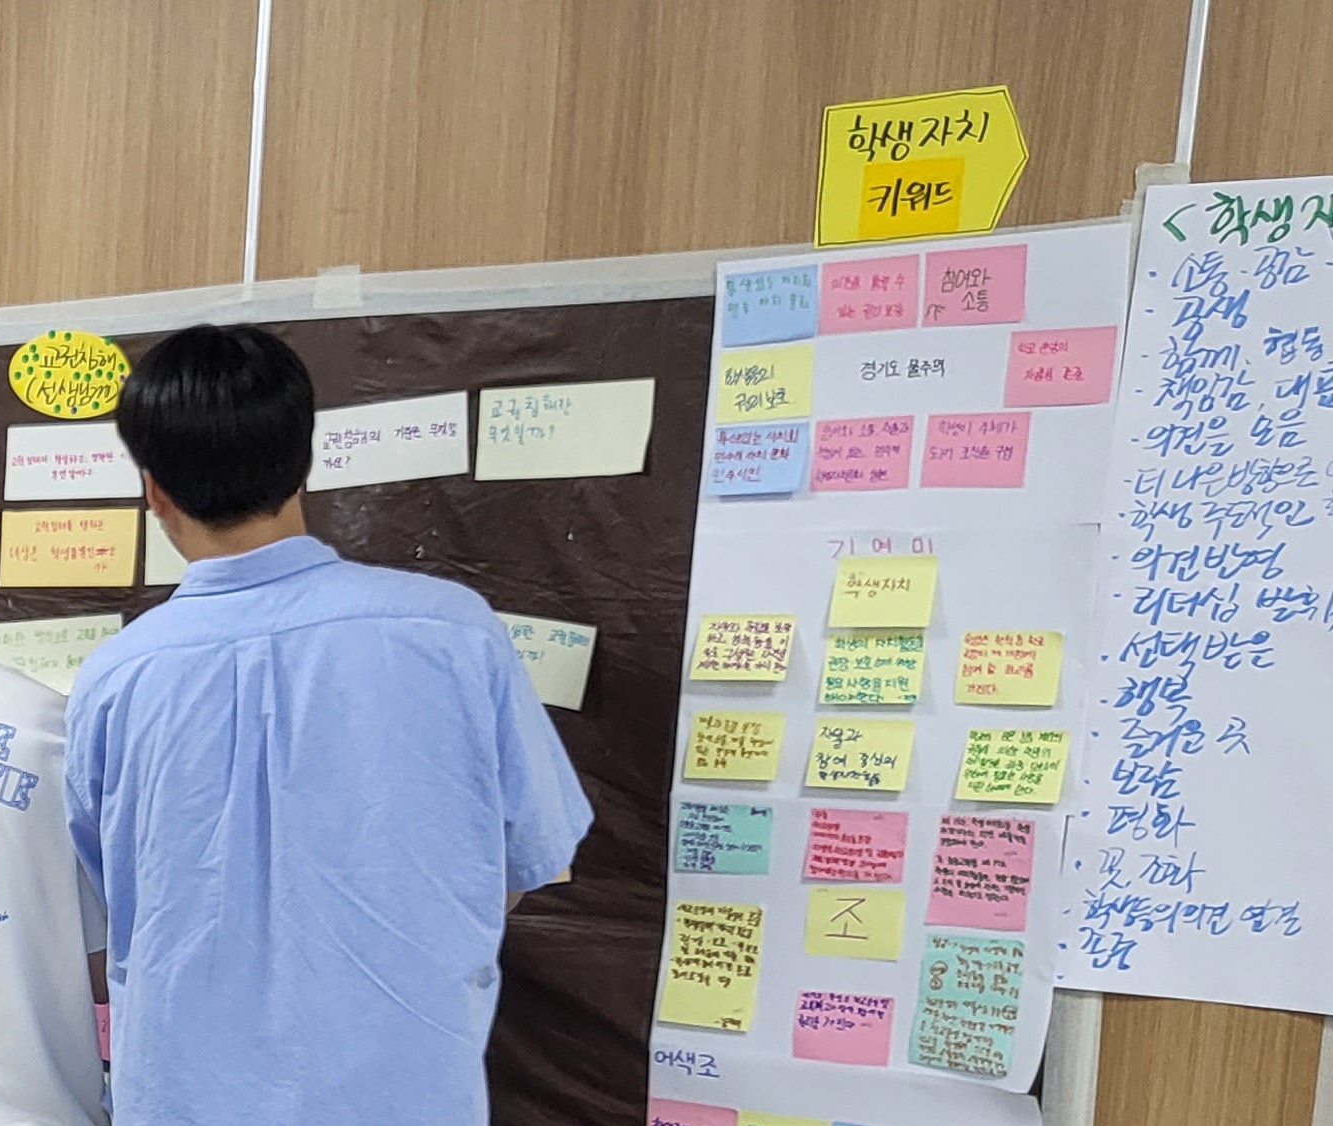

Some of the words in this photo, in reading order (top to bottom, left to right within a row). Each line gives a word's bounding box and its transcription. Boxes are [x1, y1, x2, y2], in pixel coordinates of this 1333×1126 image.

[866, 178, 954, 217] 키워드
[962, 289, 989, 312] 소통
[1107, 801, 1196, 848] 평화
[824, 898, 869, 940] 조
[654, 1050, 720, 1078] 어색조
